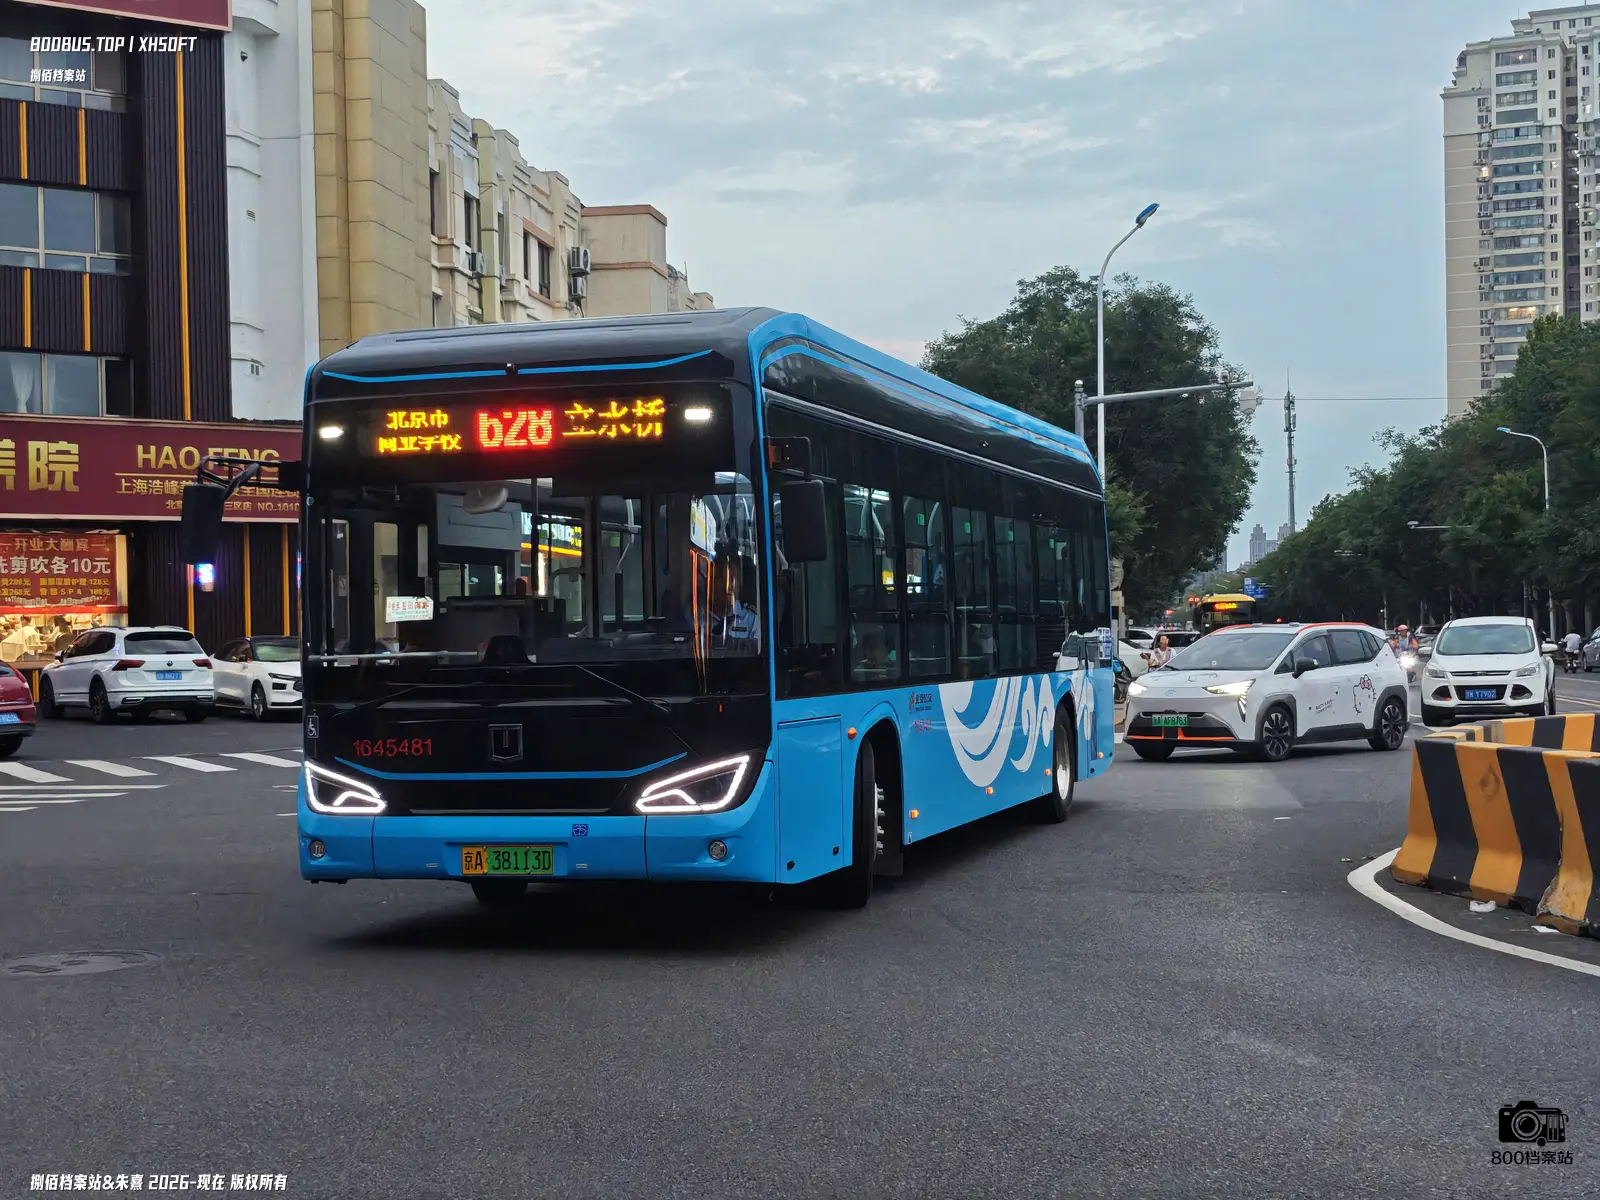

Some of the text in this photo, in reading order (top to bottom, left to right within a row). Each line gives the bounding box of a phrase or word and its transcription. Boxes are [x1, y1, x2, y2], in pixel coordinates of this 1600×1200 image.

[137, 444, 201, 471] HAO
[353, 738, 432, 757] 1645481
[463, 850, 552, 870] 京A 38113D
